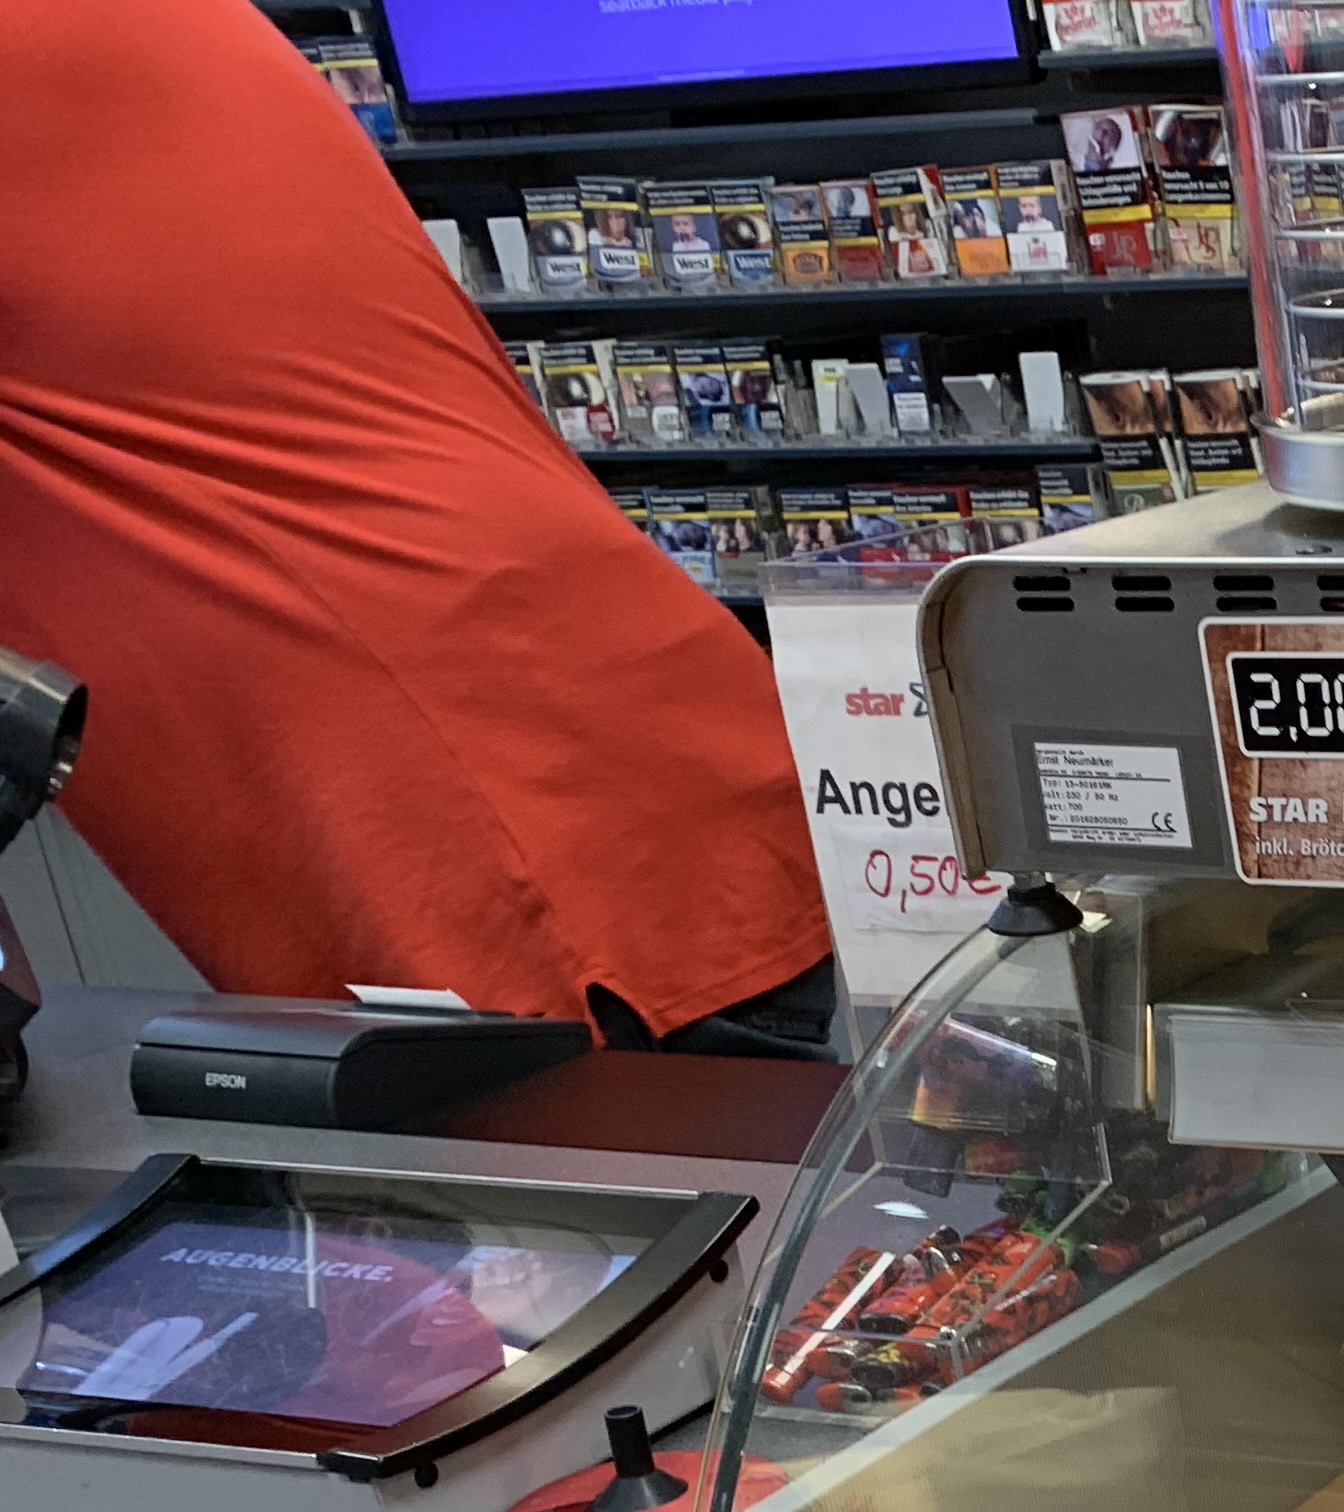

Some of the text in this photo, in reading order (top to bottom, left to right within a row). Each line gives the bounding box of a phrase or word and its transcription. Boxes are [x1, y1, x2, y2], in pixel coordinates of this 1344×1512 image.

[845, 687, 905, 717] star
[1255, 837, 1294, 858] inkl.
[205, 1072, 246, 1090] EPSON
